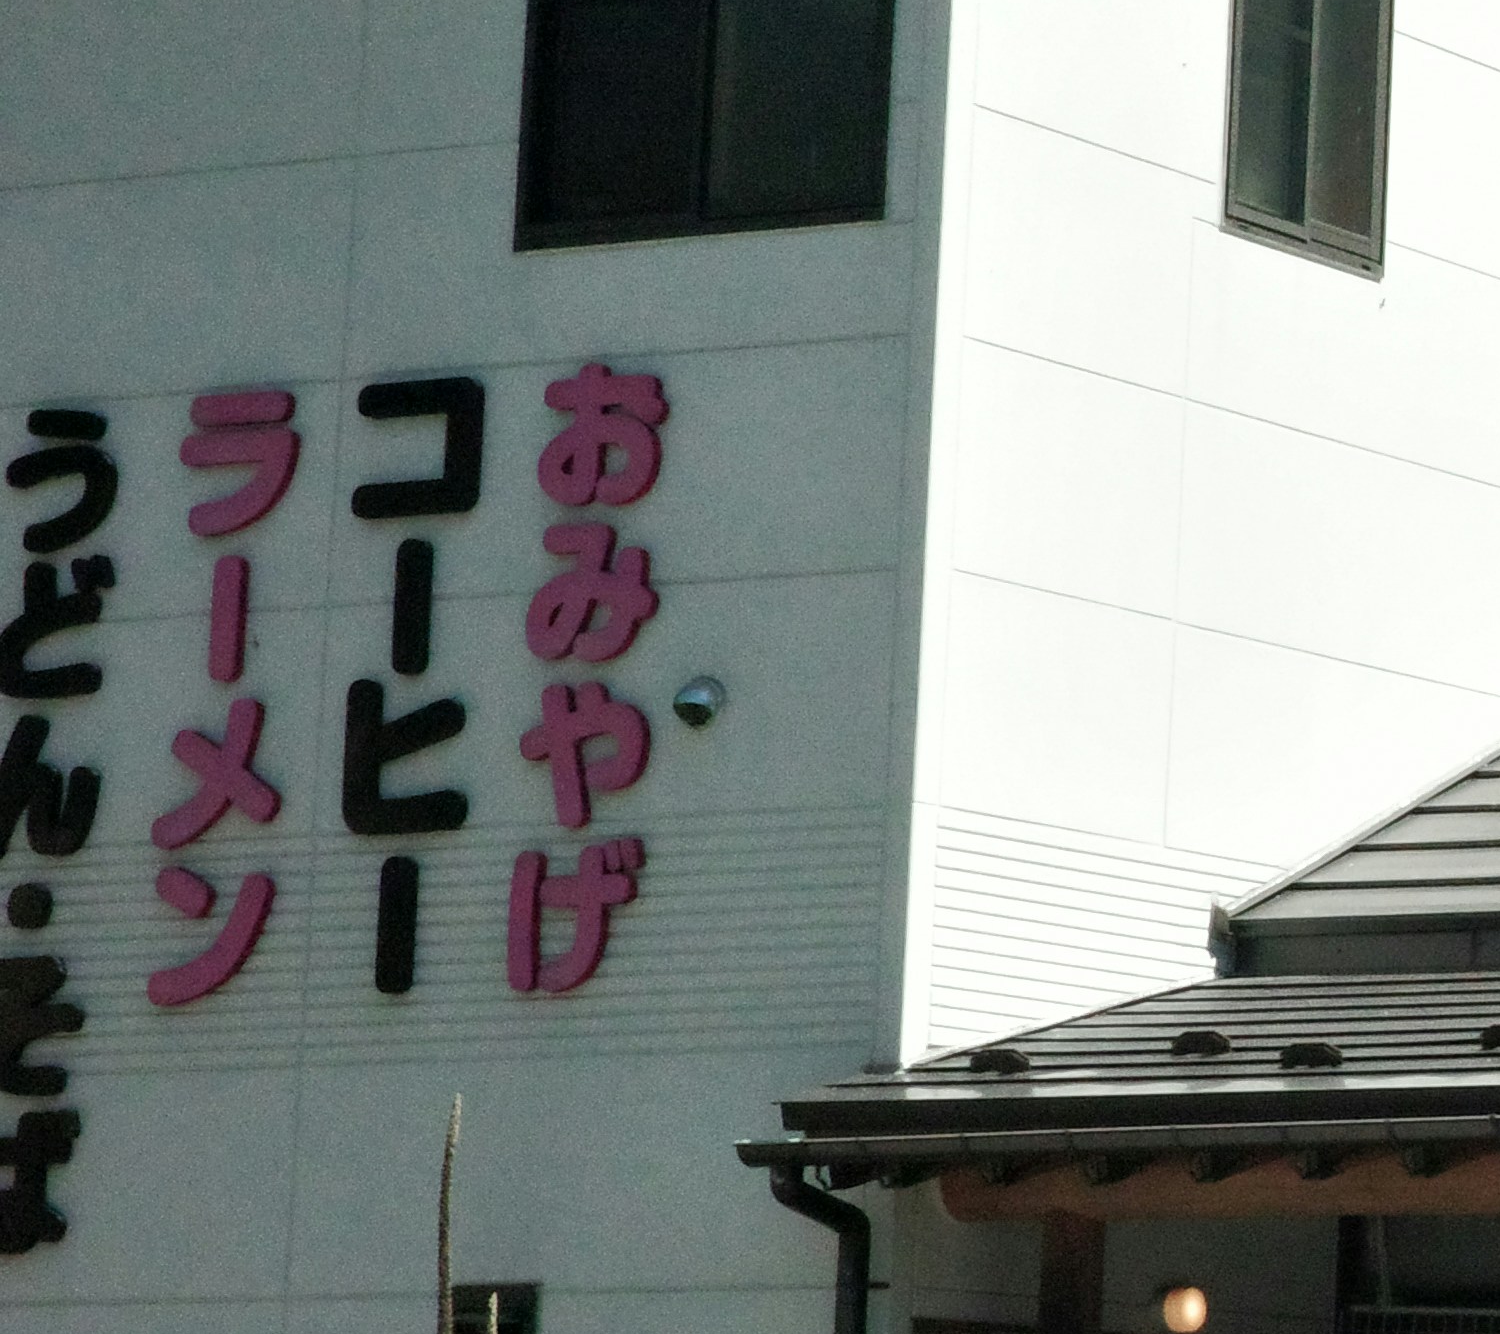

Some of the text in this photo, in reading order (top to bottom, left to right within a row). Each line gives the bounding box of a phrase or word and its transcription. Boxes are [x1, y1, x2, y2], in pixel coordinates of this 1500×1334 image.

[147, 389, 301, 1007] ラーメン
[342, 375, 485, 995] コーヒー
[506, 362, 670, 993] おみやげ
